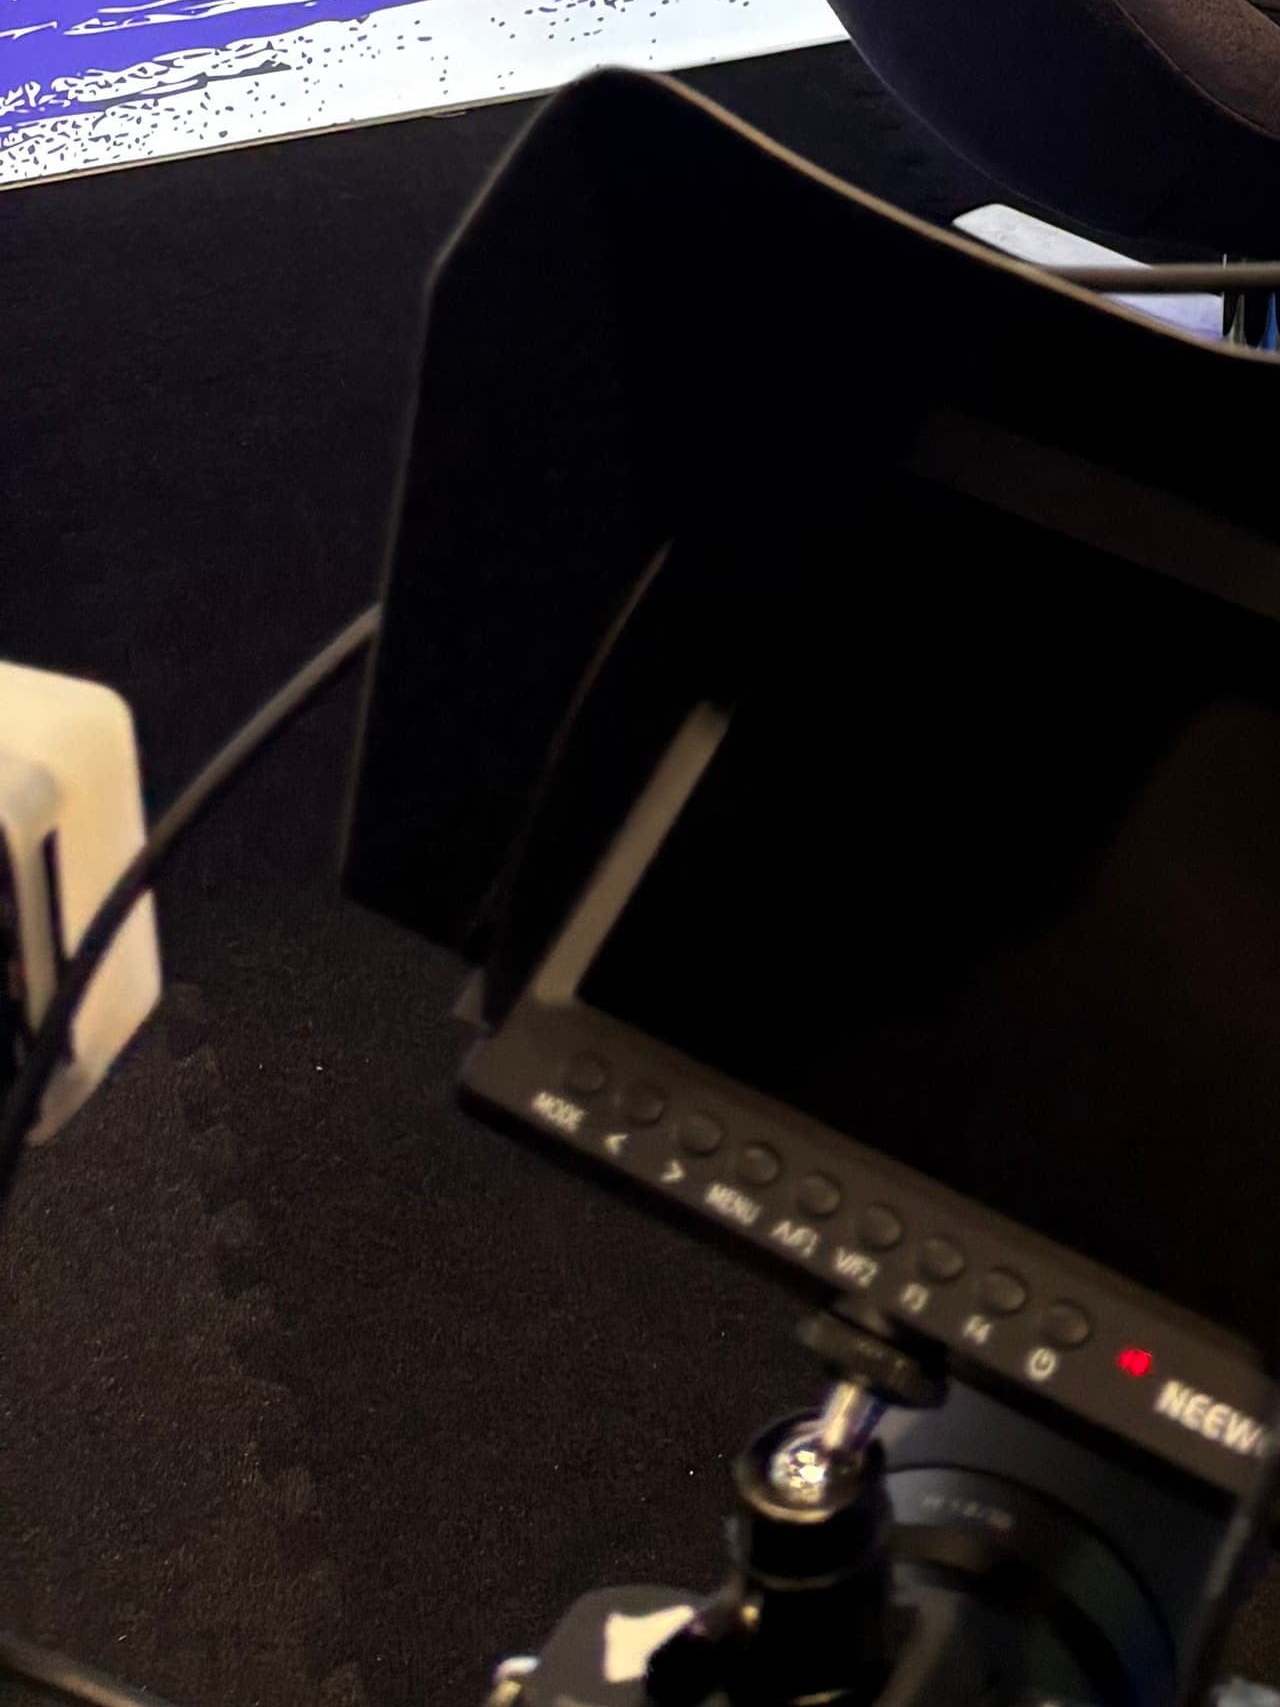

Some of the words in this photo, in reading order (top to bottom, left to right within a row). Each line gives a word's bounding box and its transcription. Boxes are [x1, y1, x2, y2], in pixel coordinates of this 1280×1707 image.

[532, 1091, 585, 1132] MODE
[705, 1183, 763, 1227] MENU
[962, 1314, 993, 1346] F4
[1154, 1379, 1270, 1458] NEEW
